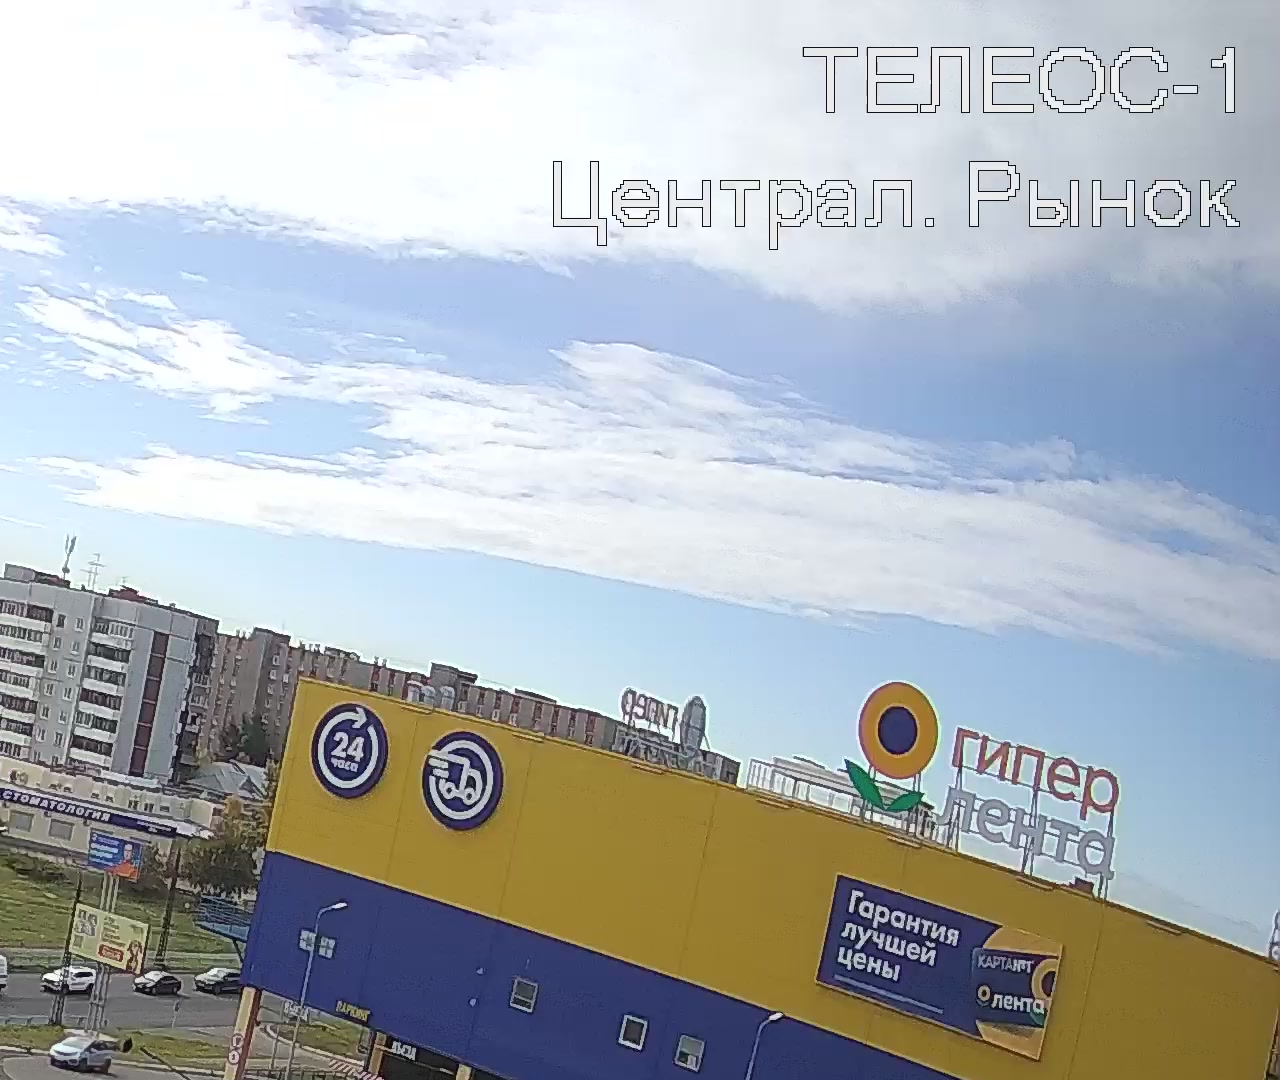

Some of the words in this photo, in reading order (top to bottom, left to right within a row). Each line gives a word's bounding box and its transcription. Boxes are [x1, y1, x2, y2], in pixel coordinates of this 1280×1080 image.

[331, 732, 365, 762] 24
[331, 758, 359, 772] часа
[952, 727, 1119, 820] гипер
[2, 790, 111, 822] СТОМАТОЛОГИЯ
[937, 785, 1115, 880] лента
[848, 889, 960, 946] Гарантия
[840, 922, 937, 967] лучшей
[837, 946, 900, 981] цены
[991, 994, 1044, 1013] лента
